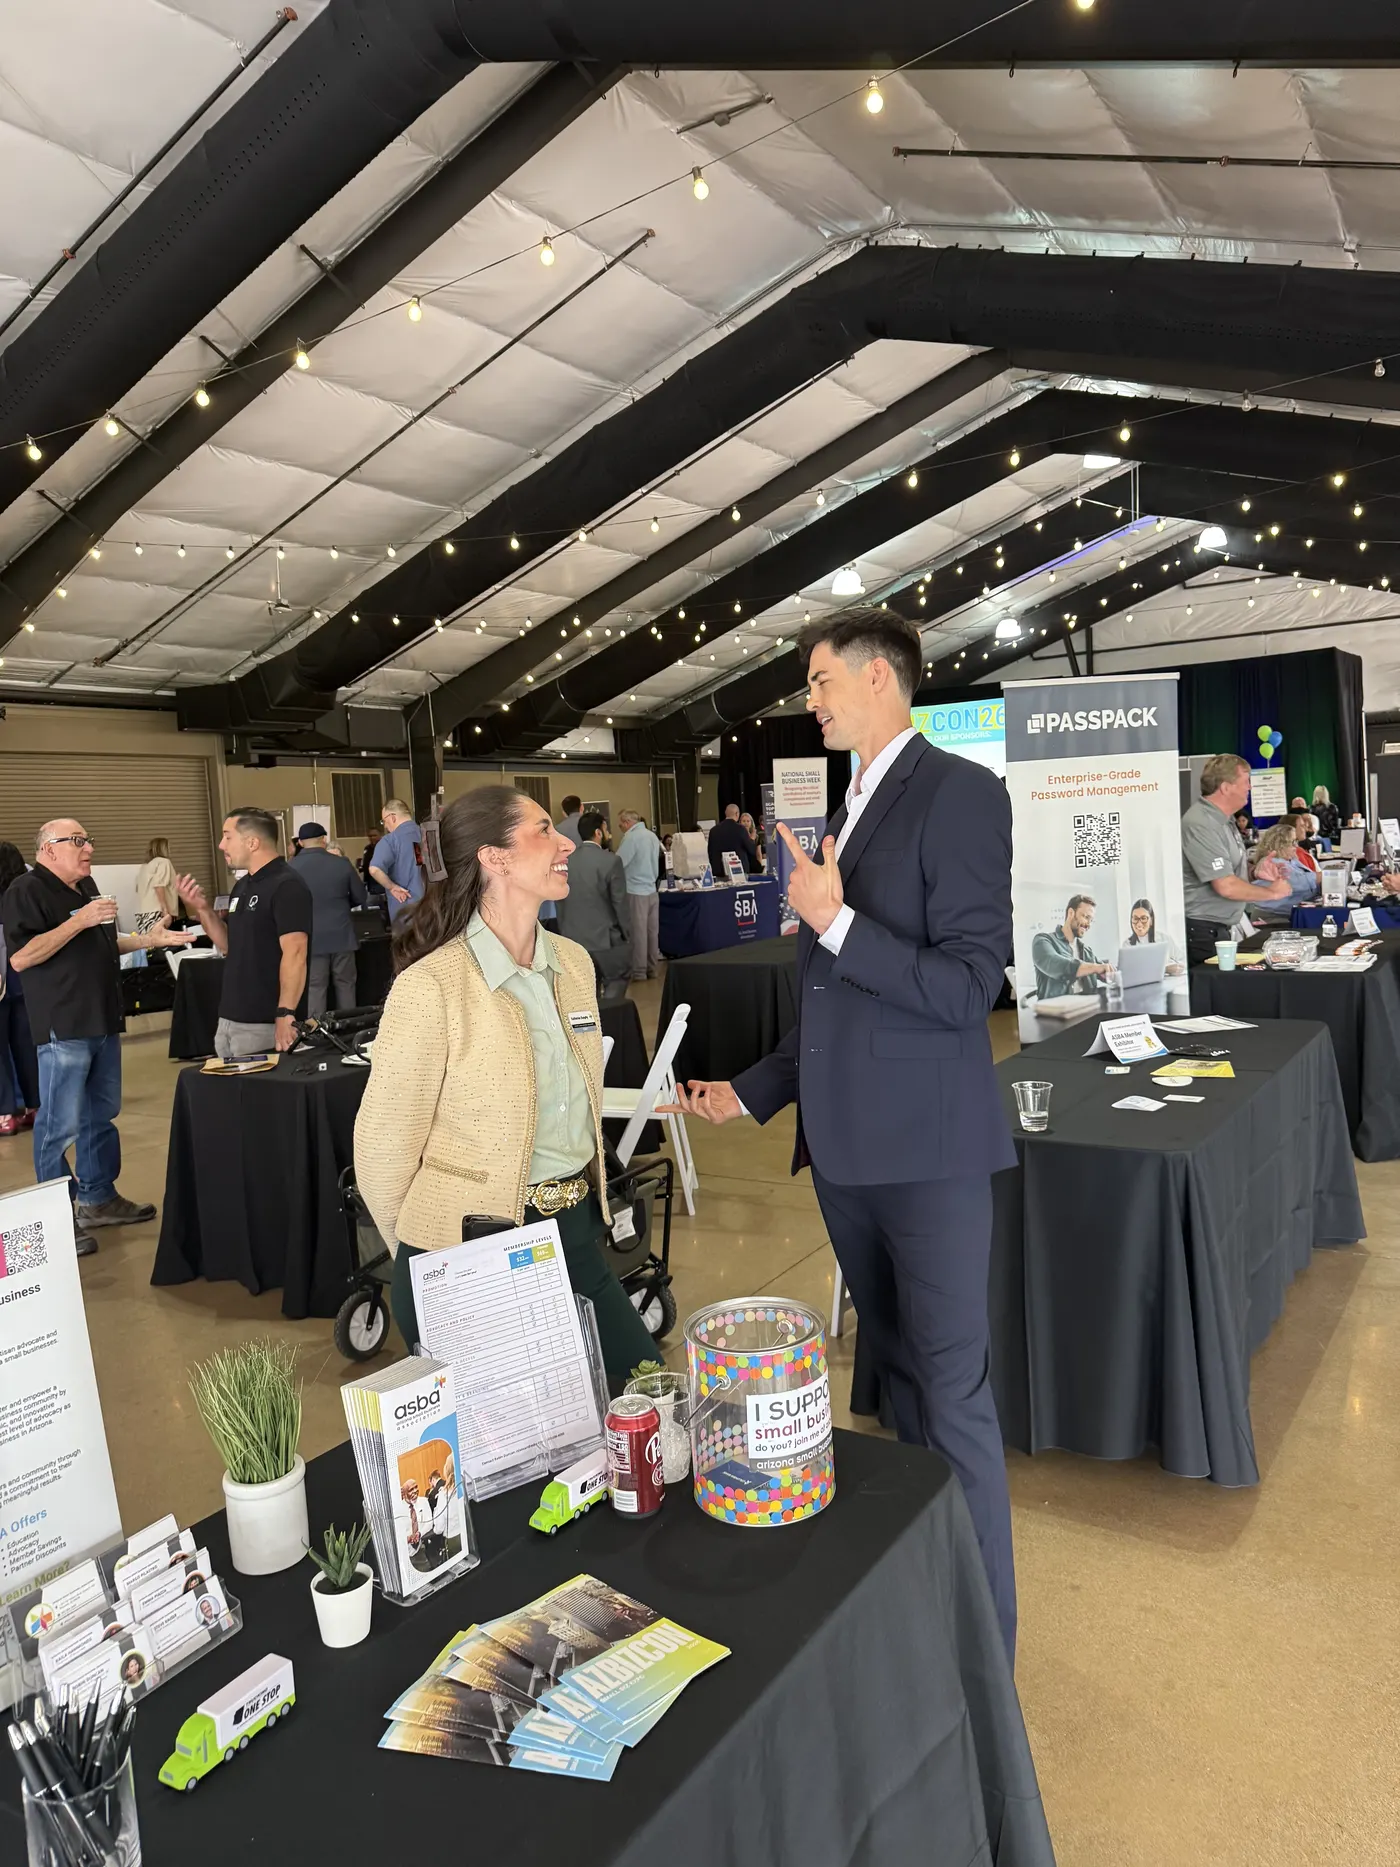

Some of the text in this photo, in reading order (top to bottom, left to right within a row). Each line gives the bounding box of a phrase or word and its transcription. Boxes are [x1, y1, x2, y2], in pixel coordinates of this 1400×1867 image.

[1046, 706, 1158, 734] PASSPACK
[1048, 769, 1141, 785] Enterprise-Grade
[1031, 782, 1159, 800] Password Management
[799, 834, 819, 850] BA
[734, 899, 758, 918] SBA
[503, 1240, 535, 1251] MEMBERSHIP
[536, 1235, 552, 1244] LEVELS
[423, 1268, 445, 1281] asba
[422, 1283, 448, 1294] PROMOTION
[426, 1322, 449, 1333] ADVOCACY
[459, 1315, 475, 1323] POLICY
[17, 1336, 45, 1350] advocate
[47, 1329, 57, 1339] and
[4, 1351, 22, 1363] small
[10, 1399, 21, 1409] and
[23, 1387, 51, 1401] empower
[24, 1393, 58, 1411] community
[394, 1389, 441, 1420] asba
[9, 1421, 24, 1433] level
[26, 1418, 32, 1426] of
[34, 1407, 62, 1423] advocacy
[10, 1415, 22, 1425] and
[23, 1402, 54, 1419] innovative
[396, 1408, 441, 1431] association
[755, 1403, 760, 1422] I
[755, 1418, 802, 1440] small
[755, 1443, 768, 1452] do
[770, 1440, 793, 1453] you?
[794, 1434, 809, 1448] join
[810, 1430, 820, 1440] me
[8, 1476, 20, 1486] and
[21, 1460, 57, 1480] community
[57, 1449, 81, 1463] through
[756, 1458, 794, 1470] arizona
[796, 1446, 818, 1464] small
[9, 1471, 50, 1494] commitment
[58, 1461, 73, 1471] their
[3, 1483, 39, 1505] meaningful
[10, 1509, 48, 1533] Offers
[7, 1530, 39, 1550] Education
[8, 1538, 40, 1558] Advocacy
[9, 1535, 62, 1566] Member Savings
[10, 1541, 67, 1574] Partner Discounts
[34, 1560, 70, 1588] More?
[571, 1623, 696, 1700] AZBIZCON
[244, 1699, 260, 1719] ONE
[262, 1684, 281, 1706] STOP
